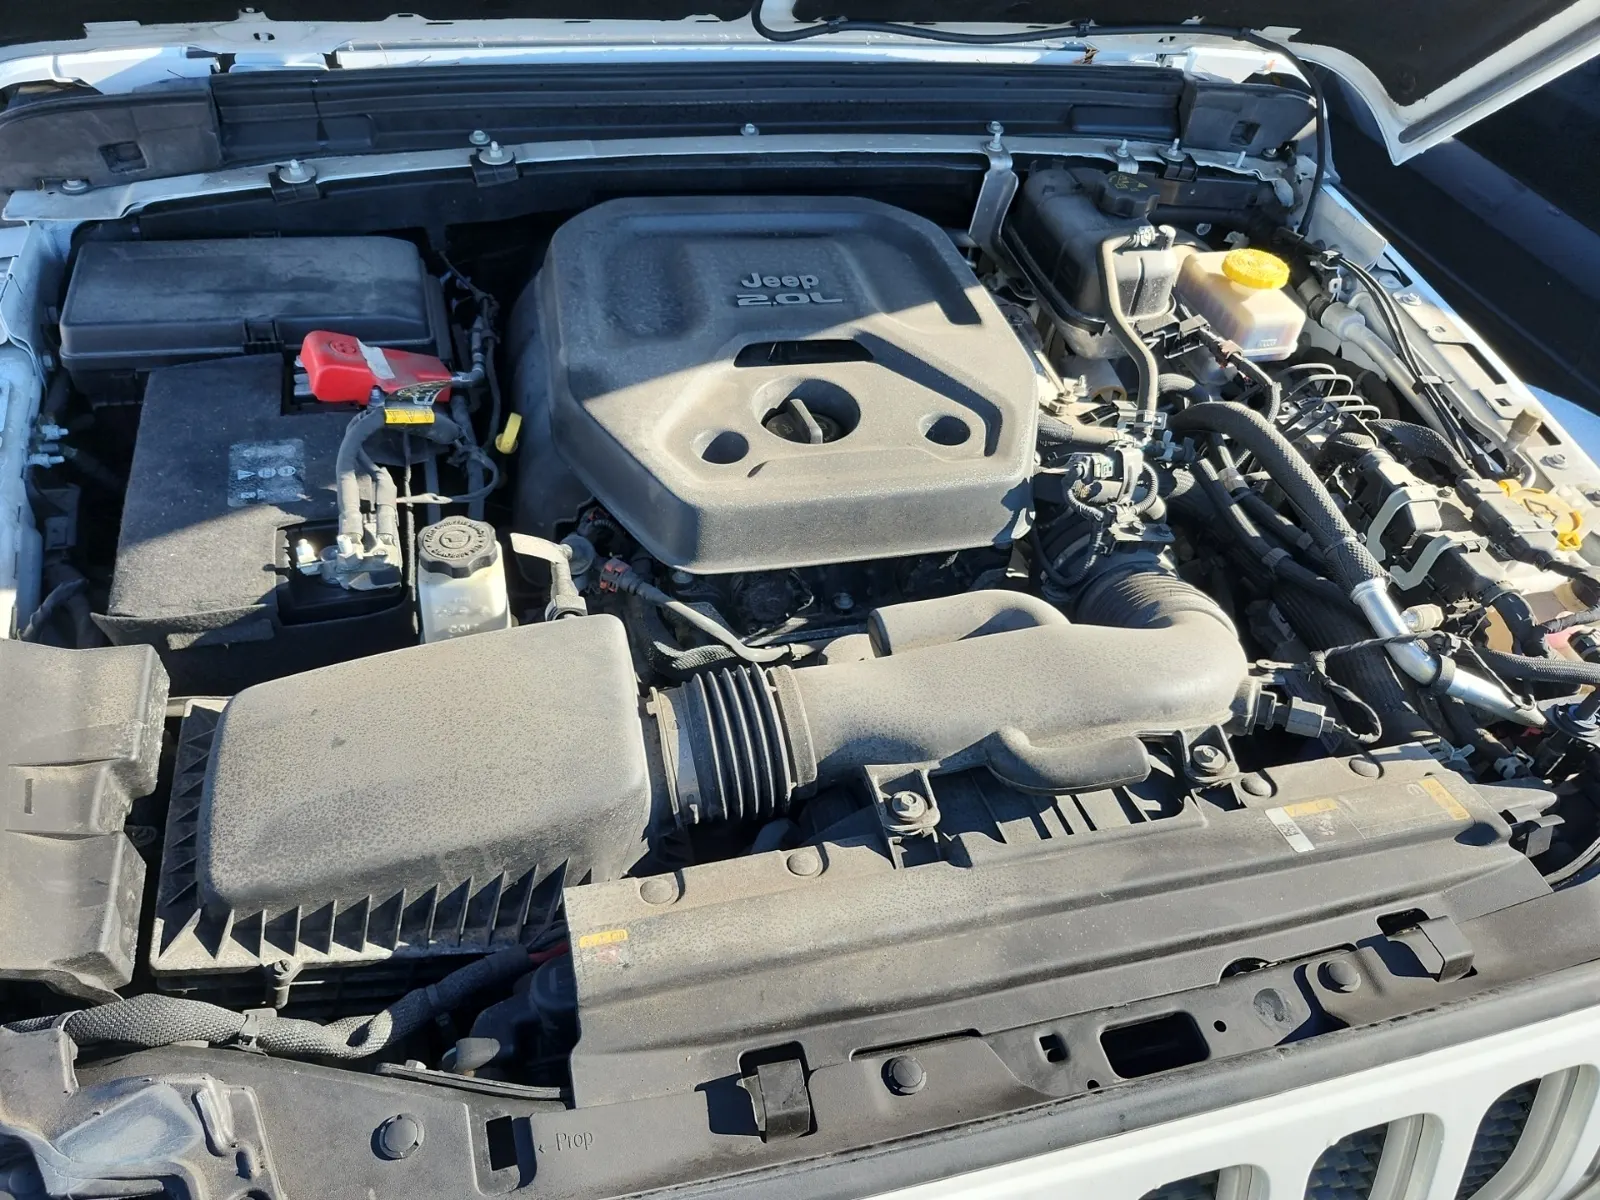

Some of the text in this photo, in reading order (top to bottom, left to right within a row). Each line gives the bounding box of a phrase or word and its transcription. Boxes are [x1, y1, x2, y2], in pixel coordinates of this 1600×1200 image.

[741, 272, 820, 290] Jeep
[736, 292, 843, 306] 2.0L
[555, 1132, 593, 1152] Prop
